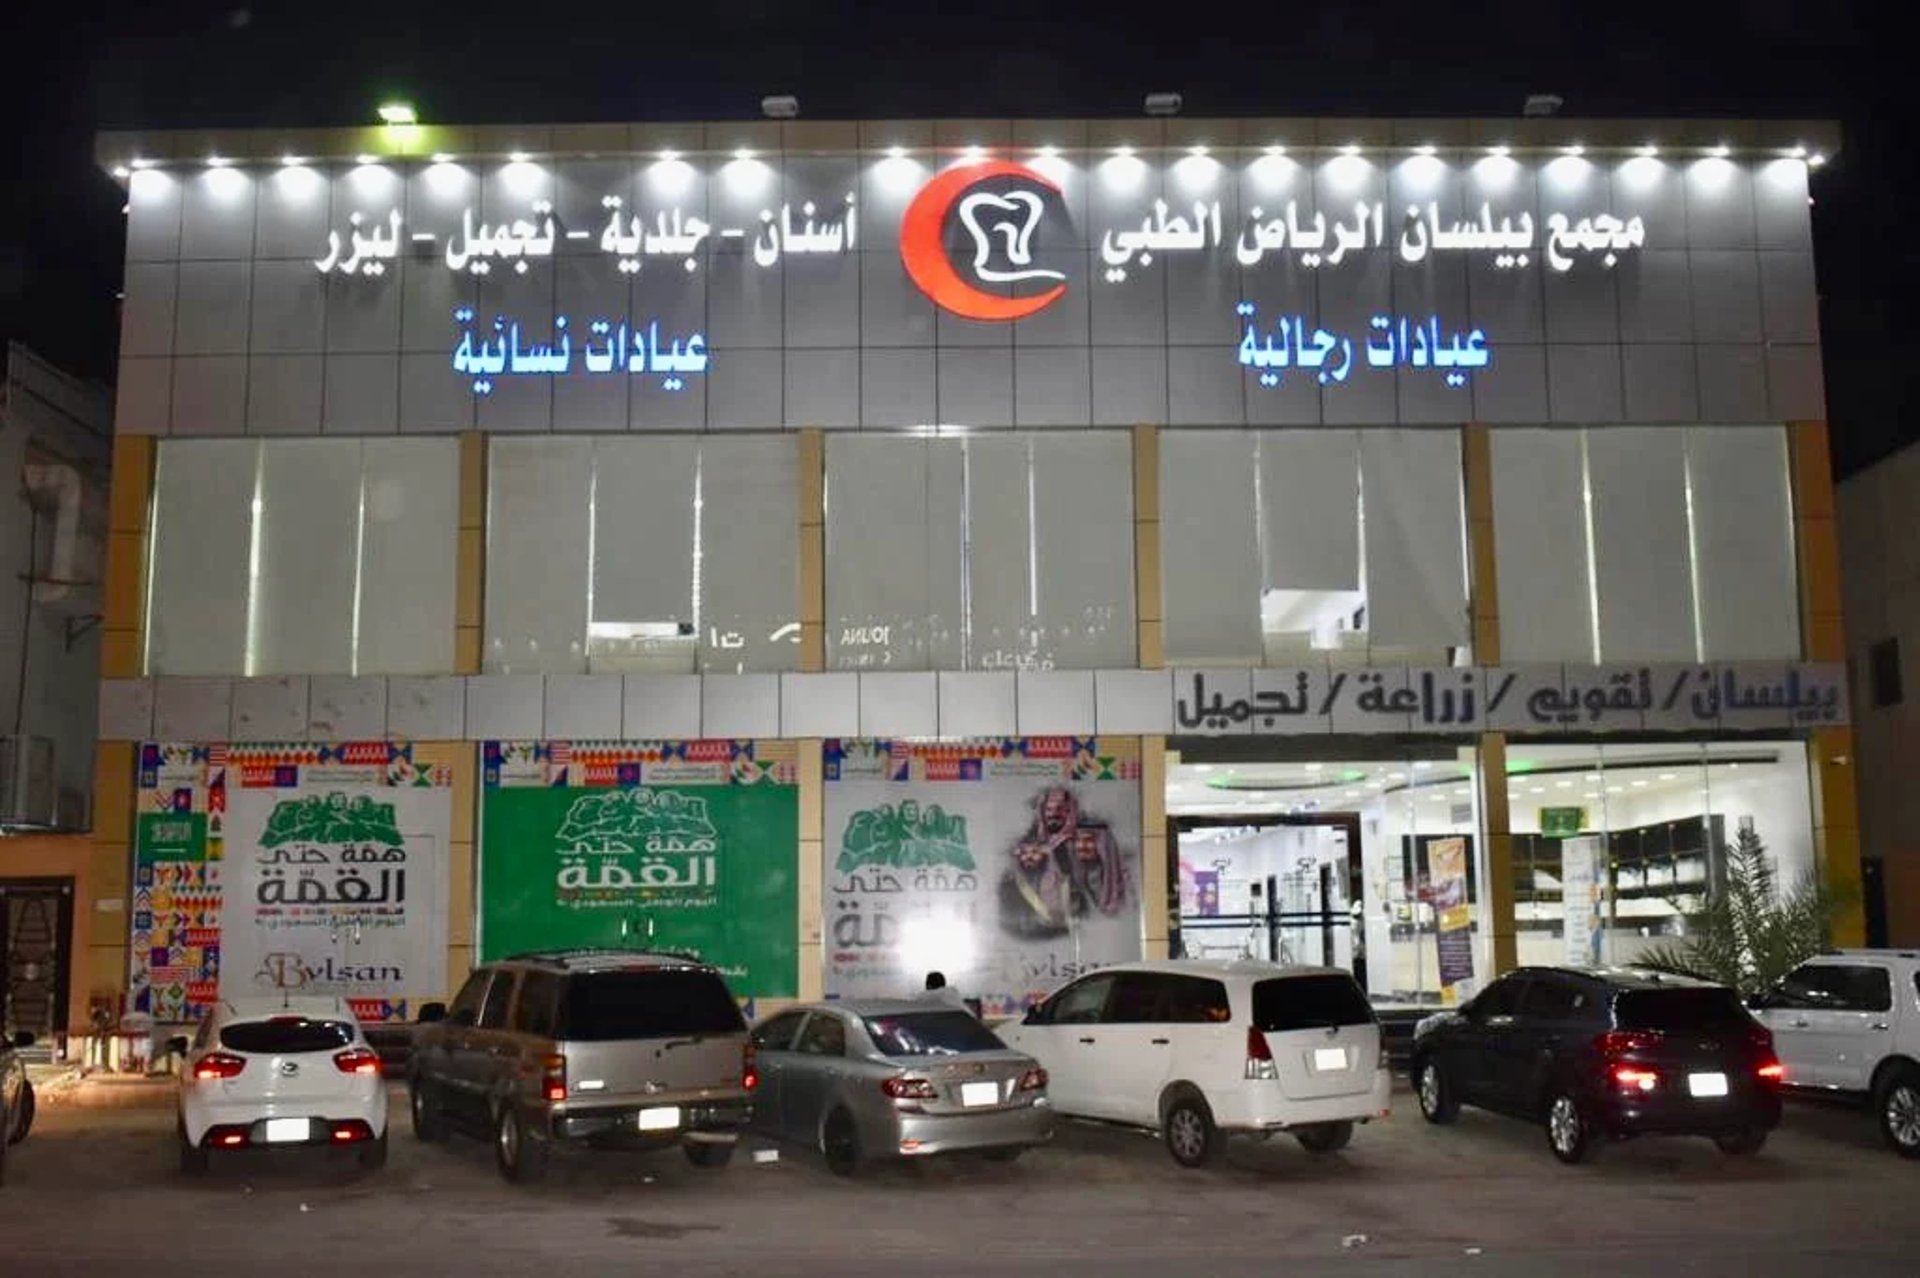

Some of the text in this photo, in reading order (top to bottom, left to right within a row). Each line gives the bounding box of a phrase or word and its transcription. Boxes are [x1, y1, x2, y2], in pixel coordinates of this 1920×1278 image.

[313, 205, 403, 275] ليزر
[445, 199, 556, 275] تجميل
[600, 194, 712, 274] جلدية
[753, 191, 857, 267] أسنان
[1100, 198, 1648, 283] مجمع بيلسان الرياض الطبي
[453, 307, 709, 394] عيادات نسائية
[1236, 301, 1490, 387] عيادات رجالية
[1177, 671, 1308, 729] تجميل
[1357, 672, 1476, 727] زراعة
[1527, 668, 1652, 724] تقويم
